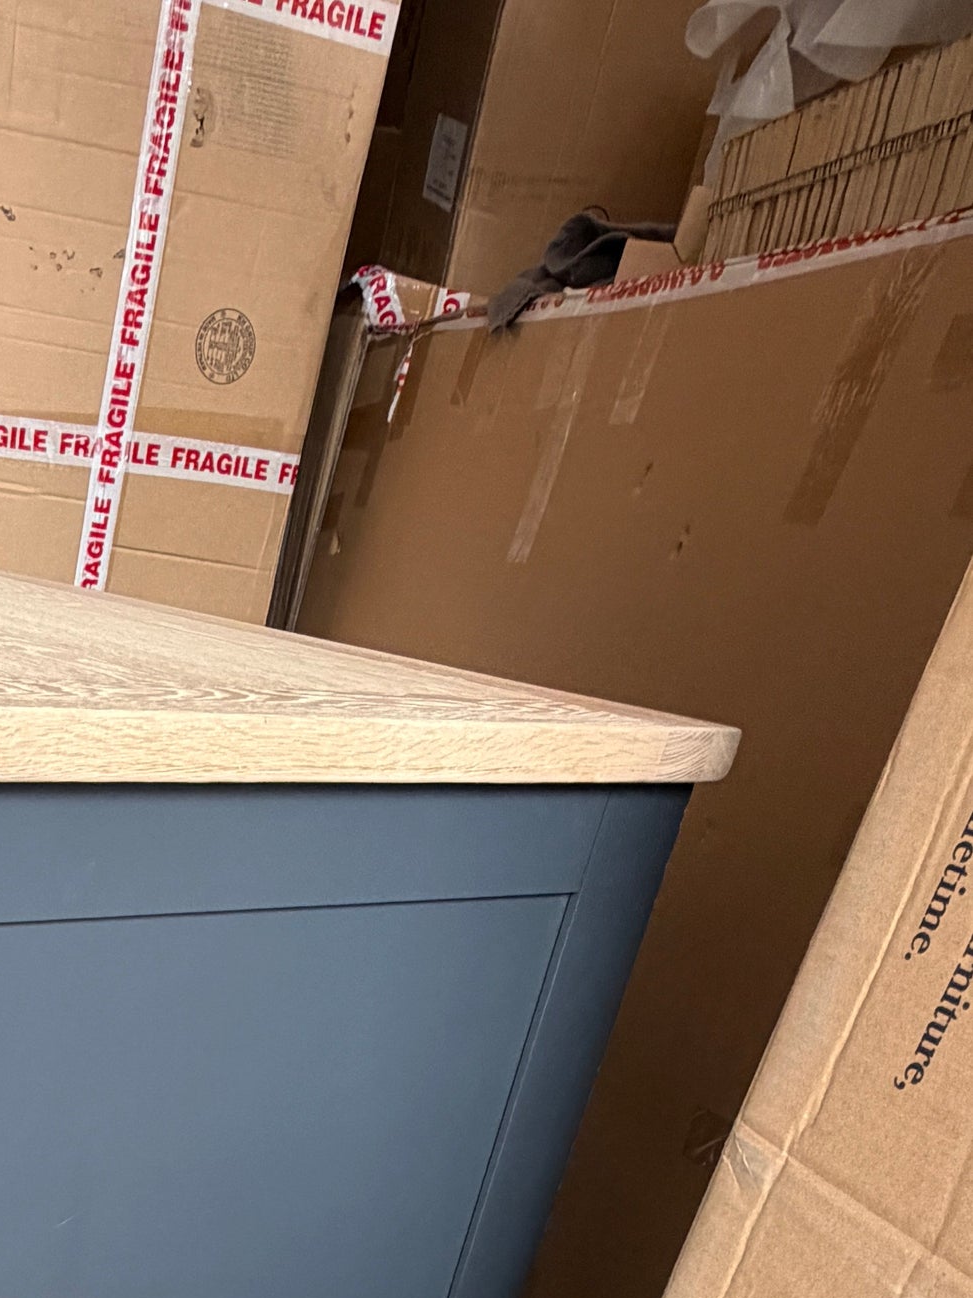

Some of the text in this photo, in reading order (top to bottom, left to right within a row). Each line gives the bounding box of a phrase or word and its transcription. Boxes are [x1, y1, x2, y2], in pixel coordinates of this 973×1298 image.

[80, 498, 112, 589] RAGILE
[97, 359, 136, 485] FRAGILE
[120, 211, 160, 347] FRAGILE
[144, 48, 185, 197] FRAGILE
[170, 447, 270, 481] FRAGILE
[904, 812, 973, 960] etime.
[894, 932, 973, 1090] niture,
